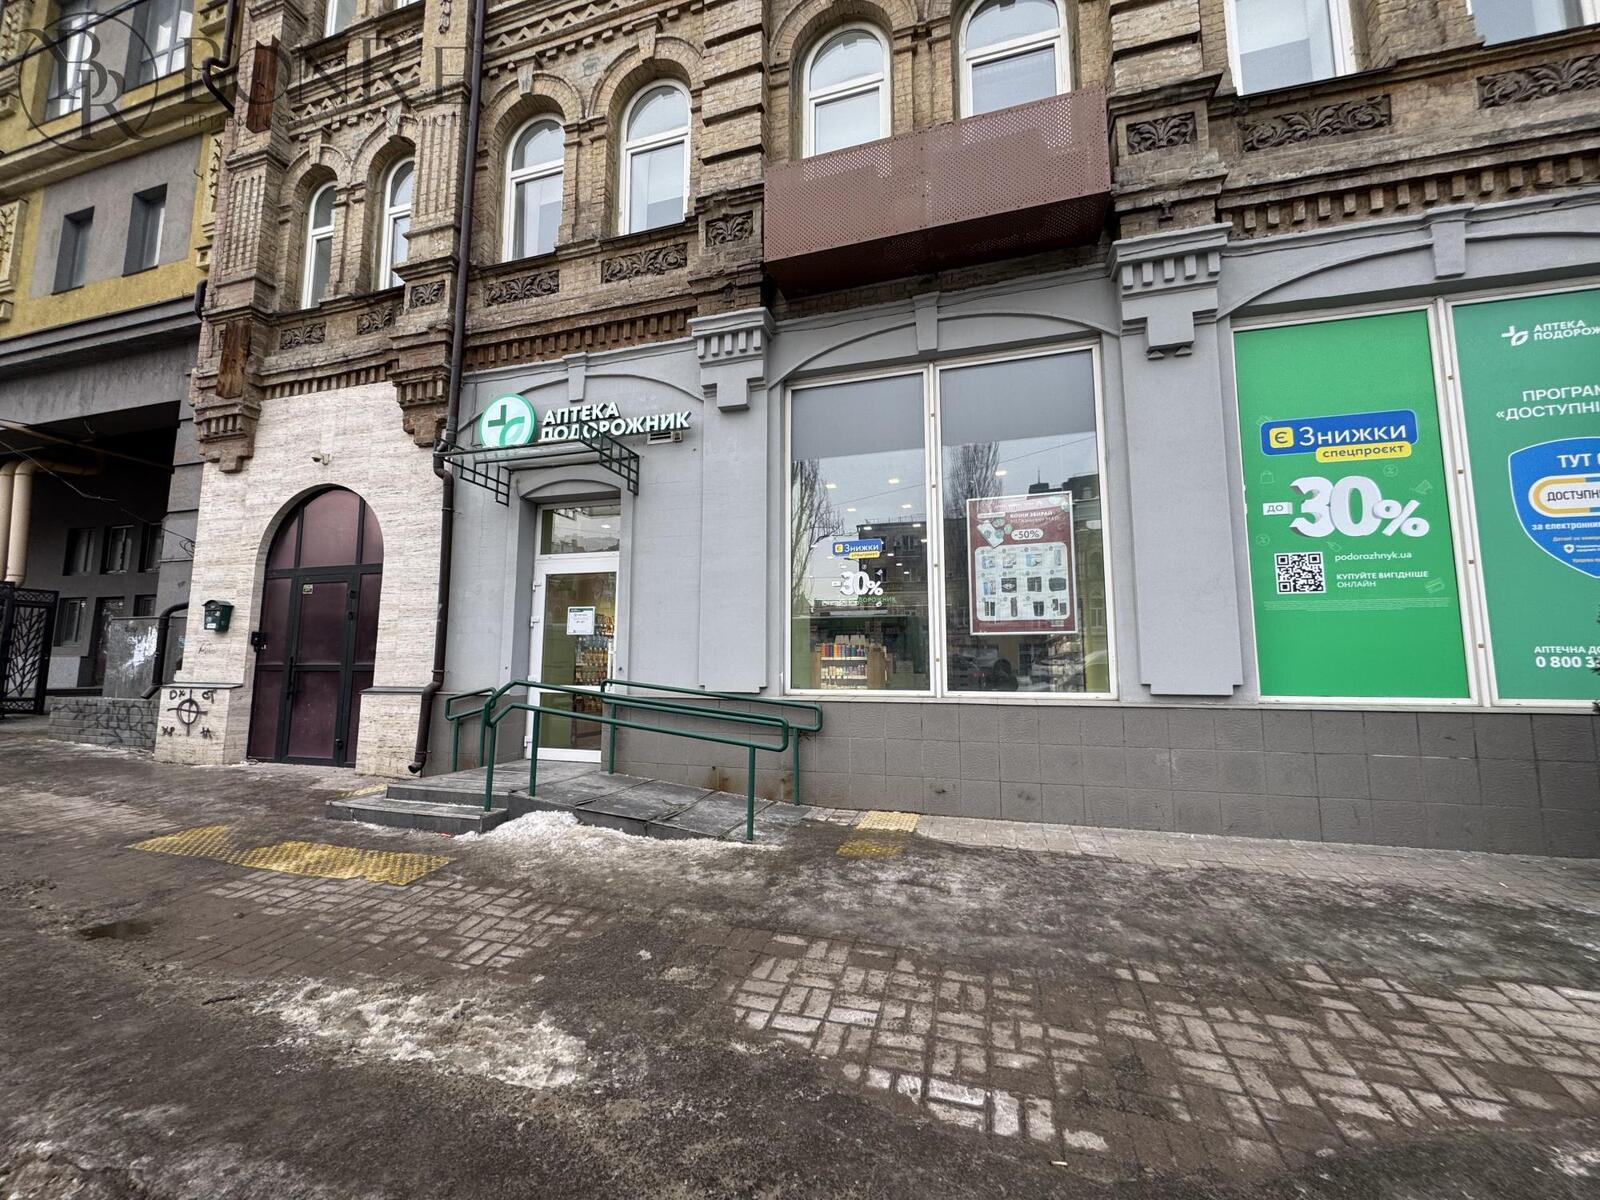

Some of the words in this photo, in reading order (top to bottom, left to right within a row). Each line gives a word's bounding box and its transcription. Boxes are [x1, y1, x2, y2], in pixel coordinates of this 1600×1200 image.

[1533, 320, 1586, 333] АПТЕКА
[543, 402, 620, 425] АПТЕКА
[540, 410, 692, 440] ПОДОРОЖНИК
[1299, 424, 1408, 447] Знижки
[1322, 444, 1405, 459] спецпроєкт
[1556, 453, 1592, 468] ТУТ
[1547, 489, 1600, 502] ДОСТУПН
[1014, 529, 1040, 540] -50%
[1335, 551, 1412, 562] podorozhnyk.ua
[1336, 571, 1377, 580] КУПУЙТЕ
[1336, 580, 1376, 588] ОНЛАЙН
[1534, 645, 1586, 654] АПТЕЧНА
[1536, 656, 1546, 667] 0
[1550, 656, 1582, 668] 800
